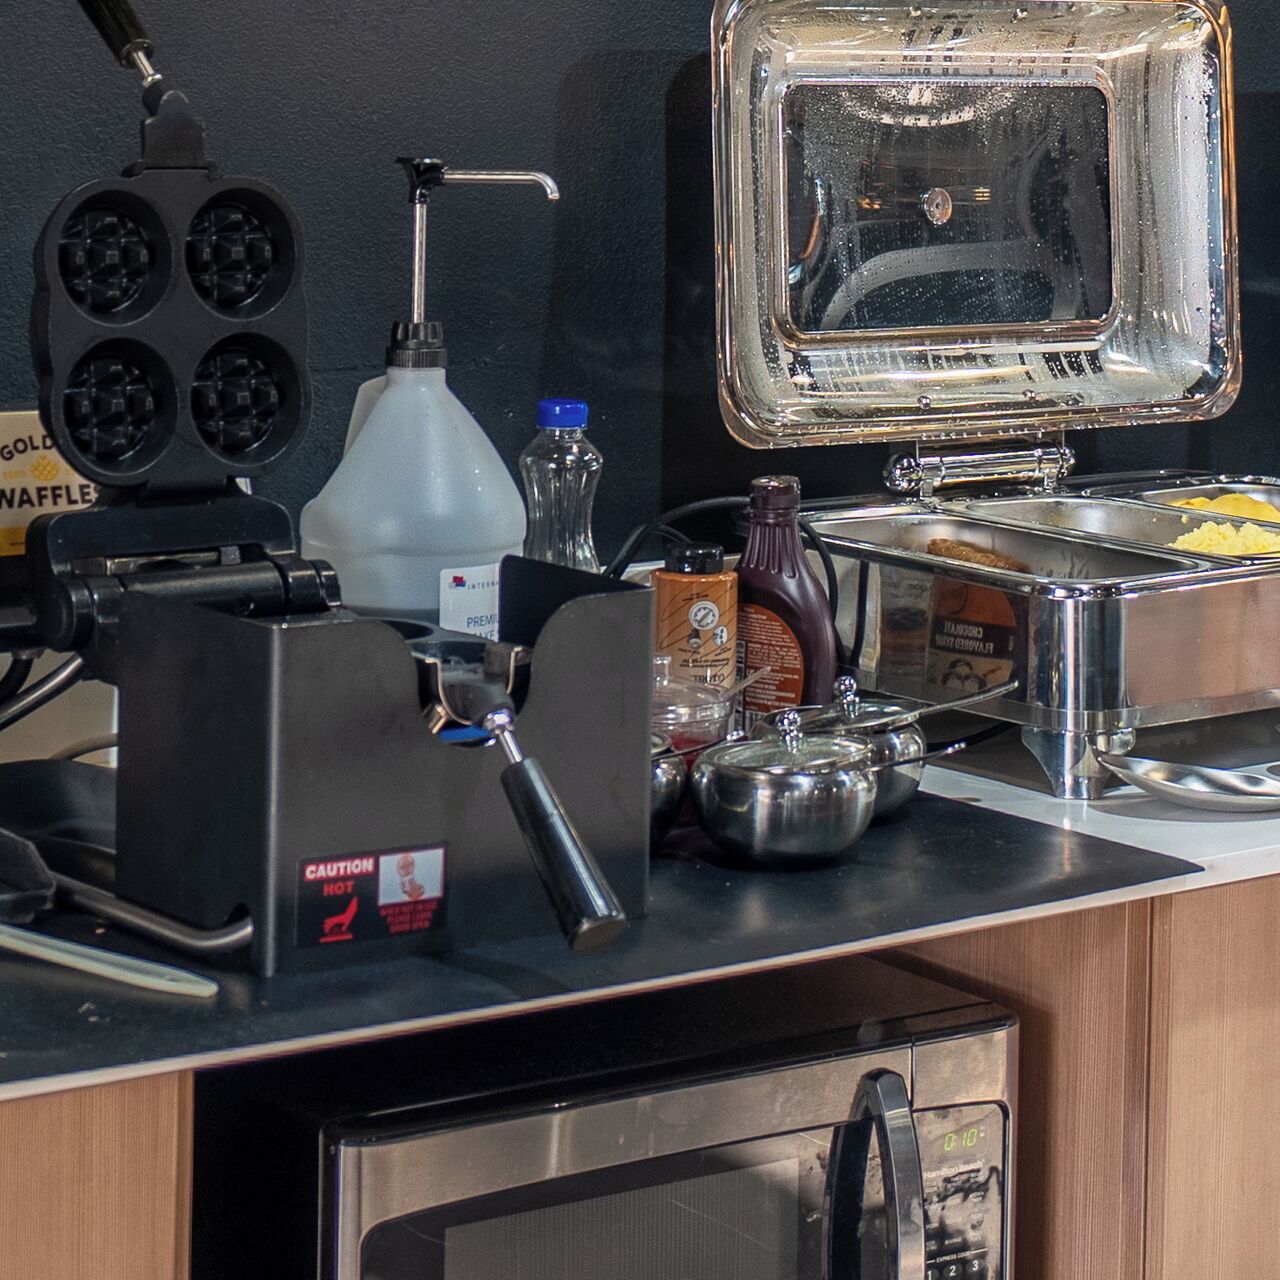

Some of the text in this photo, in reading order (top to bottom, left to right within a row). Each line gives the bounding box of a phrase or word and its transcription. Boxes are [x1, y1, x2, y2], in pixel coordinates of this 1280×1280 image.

[305, 857, 375, 880] CAUTION
[323, 880, 354, 896] HOT
[943, 1128, 978, 1152] 0:10
[923, 1165, 959, 1179] Hamilton
[949, 1265, 957, 1277] 2
[971, 1259, 980, 1271] 3
